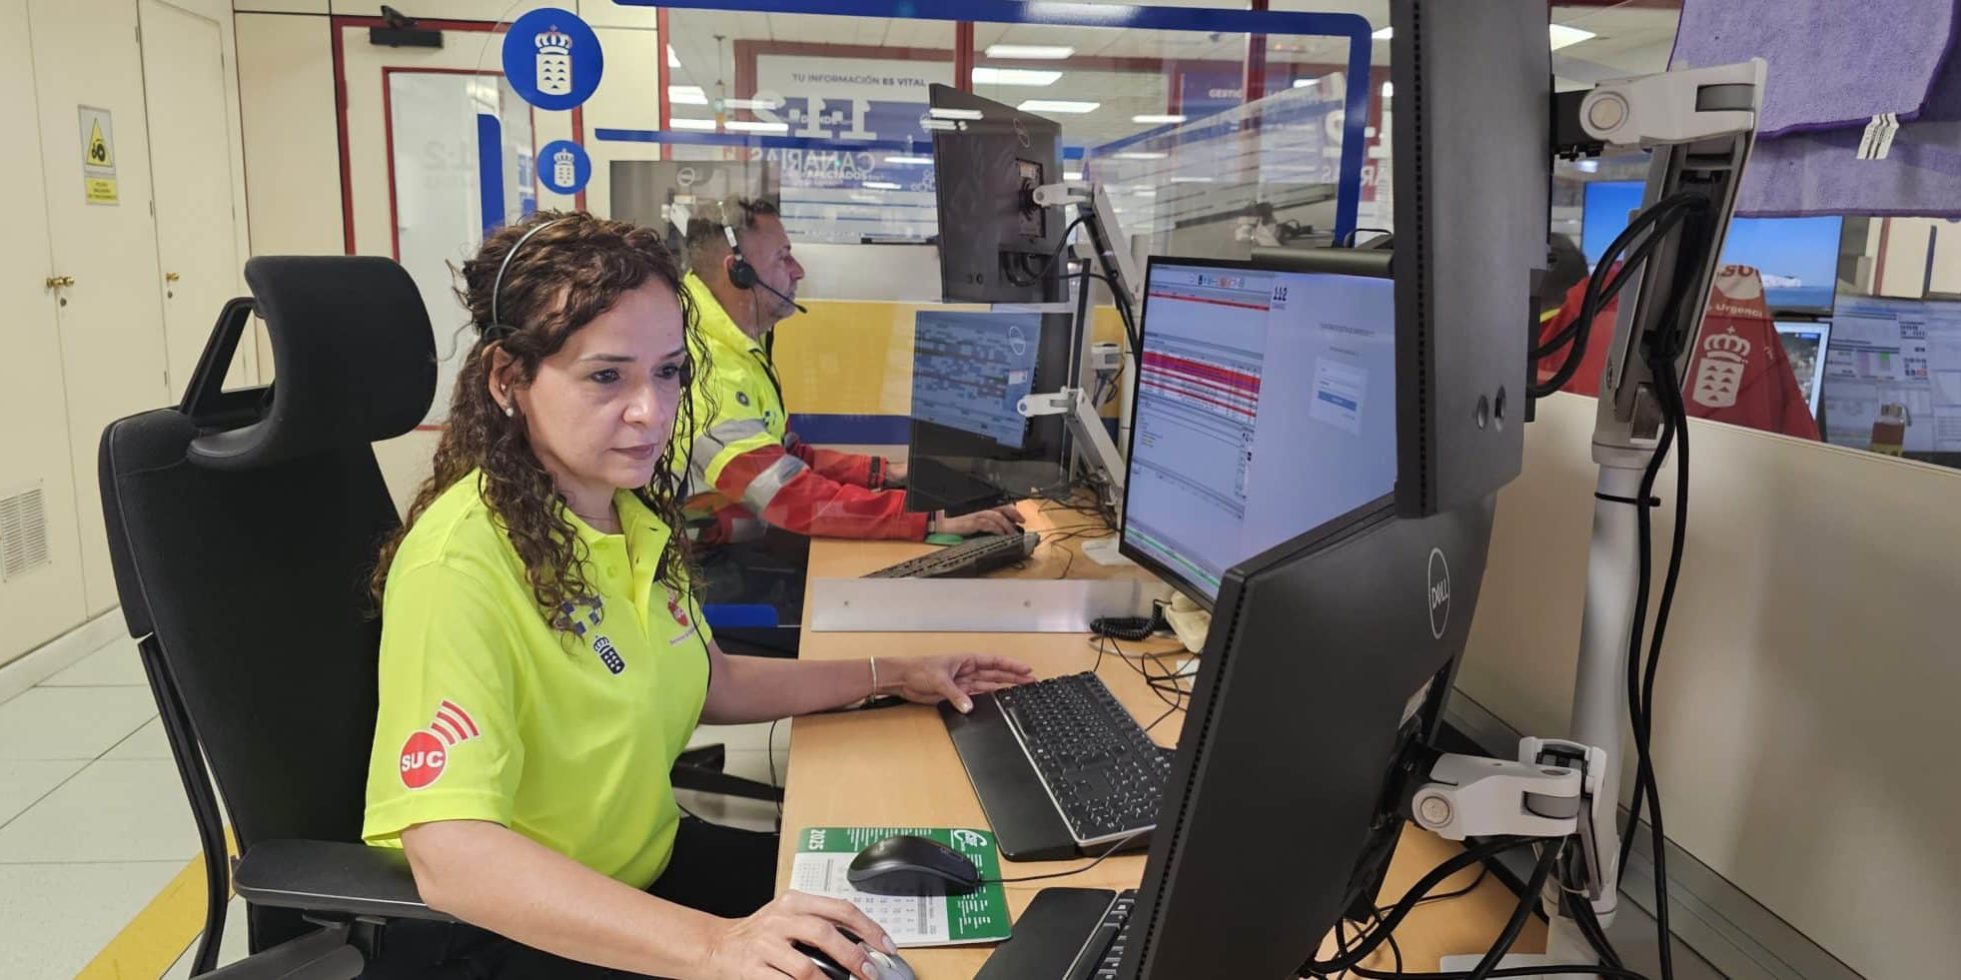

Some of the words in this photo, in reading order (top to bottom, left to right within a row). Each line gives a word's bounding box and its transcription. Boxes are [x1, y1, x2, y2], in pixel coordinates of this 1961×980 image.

[792, 74, 805, 82] TU
[807, 74, 880, 86] INFORMACIÓN
[882, 77, 895, 86] ES
[898, 78, 927, 87] VITAL
[1720, 265, 1760, 280] SU
[1273, 285, 1288, 302] 112
[401, 750, 444, 772] SUC
[809, 829, 826, 851] 2025
